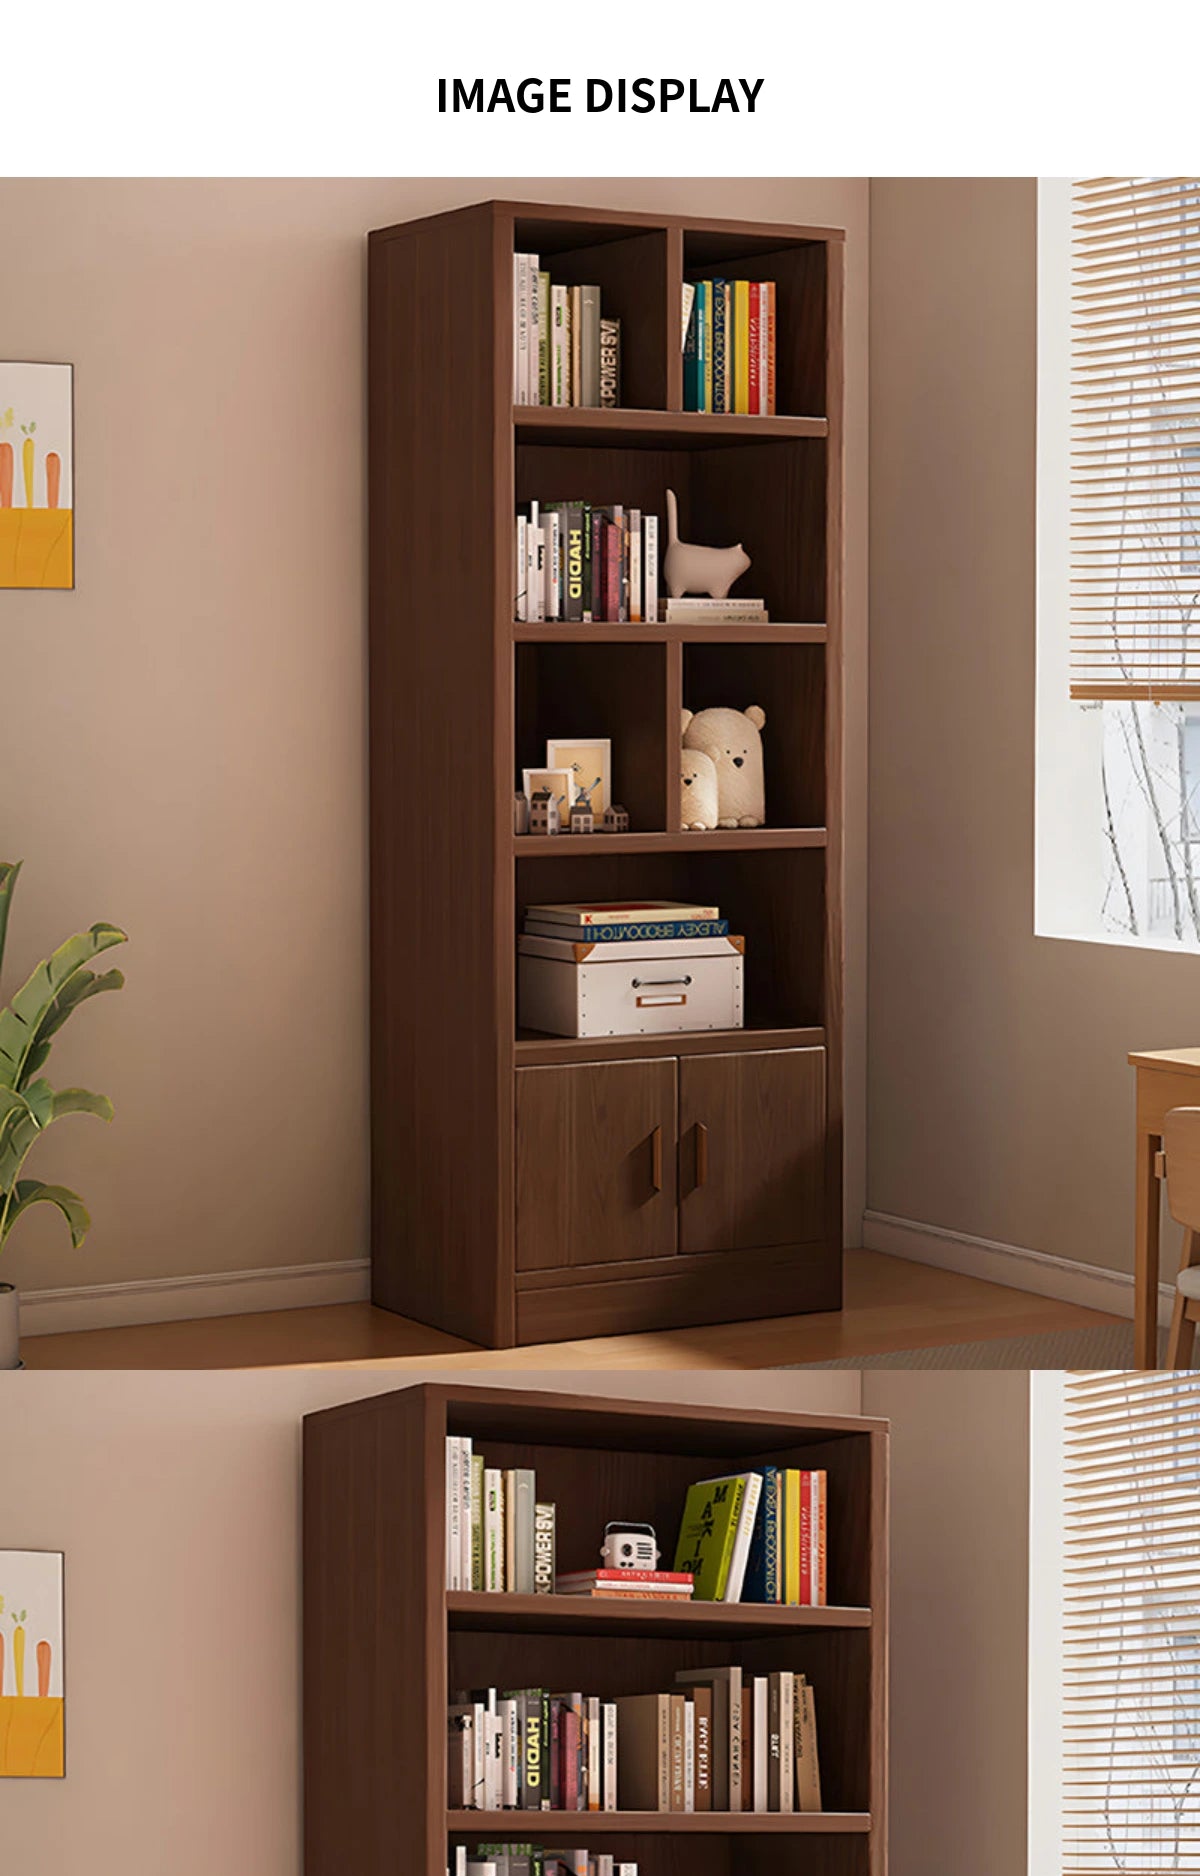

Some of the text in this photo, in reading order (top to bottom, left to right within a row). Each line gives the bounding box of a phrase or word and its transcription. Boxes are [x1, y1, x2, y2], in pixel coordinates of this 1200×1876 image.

[601, 347, 617, 399] POWER
[593, 922, 726, 942] ALEXEY BRODOVITCH
[535, 1532, 552, 1584] POWER
